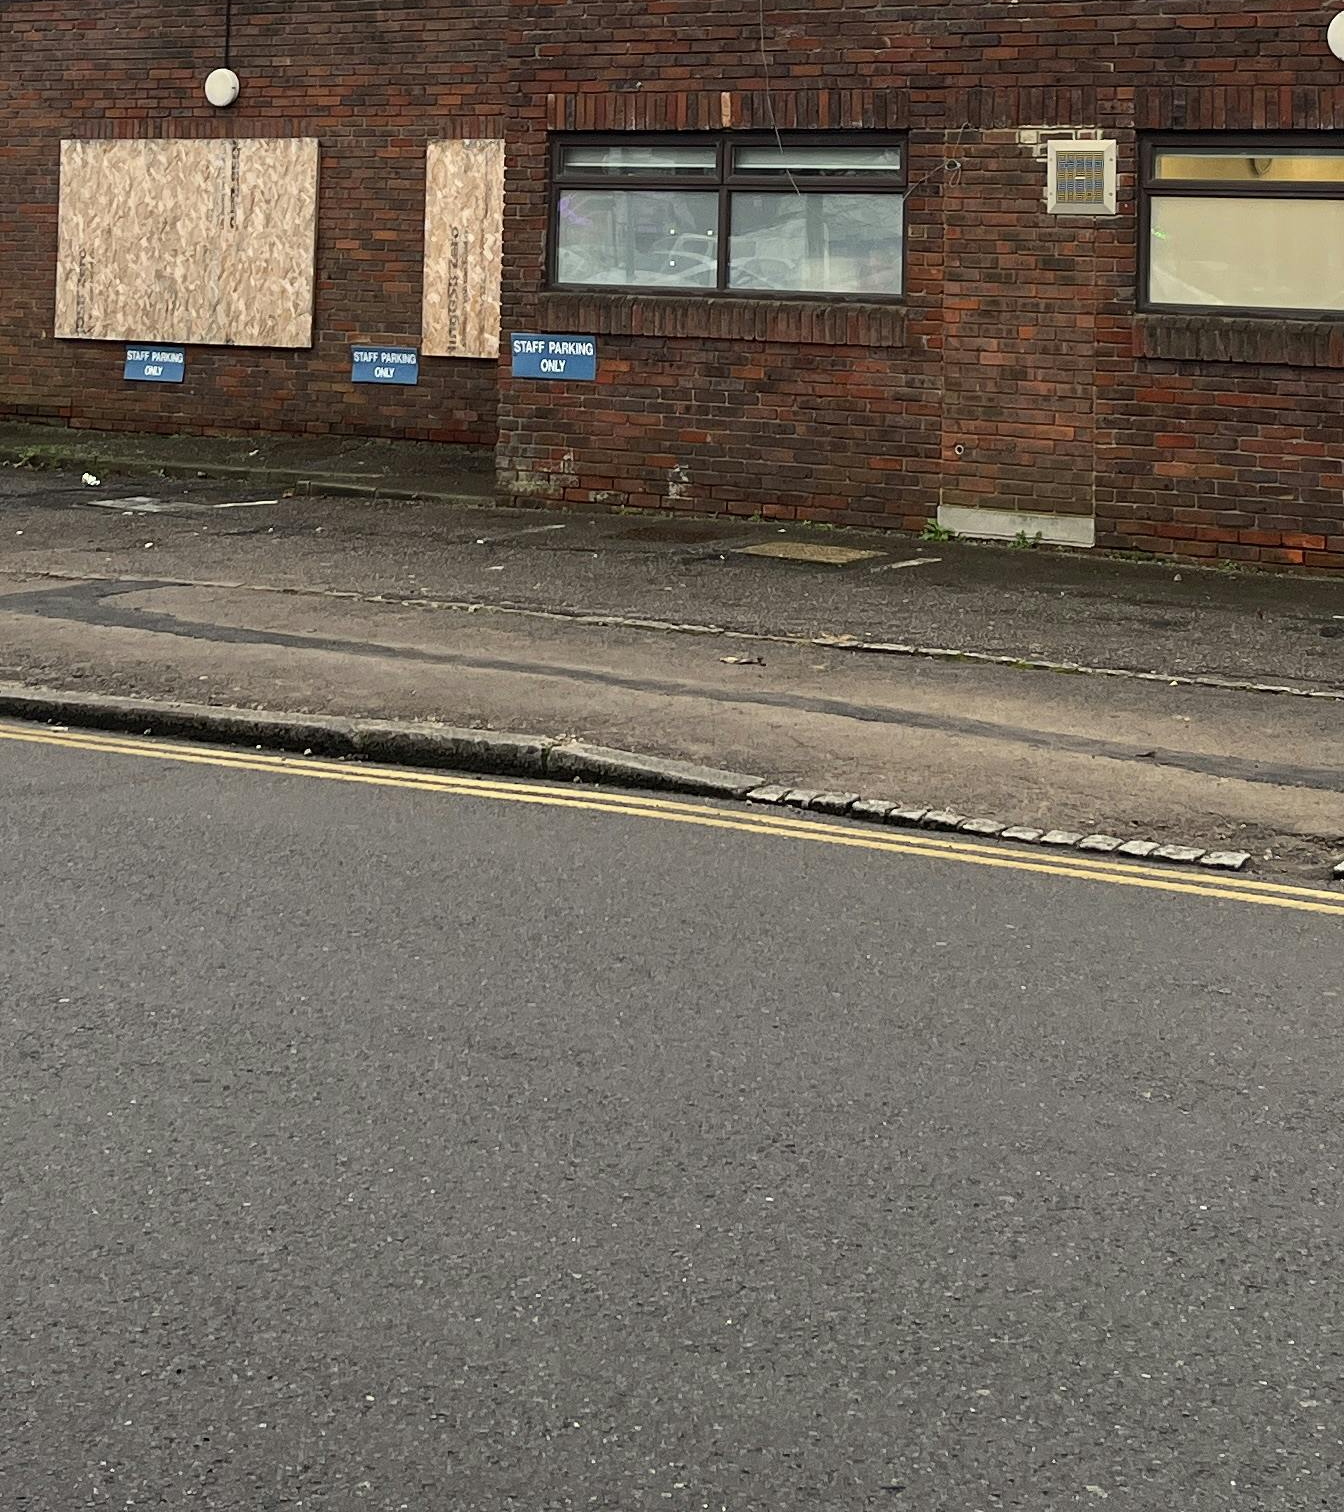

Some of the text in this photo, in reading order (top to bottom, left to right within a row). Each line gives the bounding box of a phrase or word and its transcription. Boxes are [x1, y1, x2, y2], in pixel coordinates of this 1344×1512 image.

[513, 340, 594, 356] STAFF PARKING
[127, 350, 184, 363] STAFF PARKING
[354, 351, 417, 365] STAFF PARKING
[144, 365, 163, 376] ONLY
[374, 367, 395, 378] ONLY
[540, 359, 566, 373] ONLY
